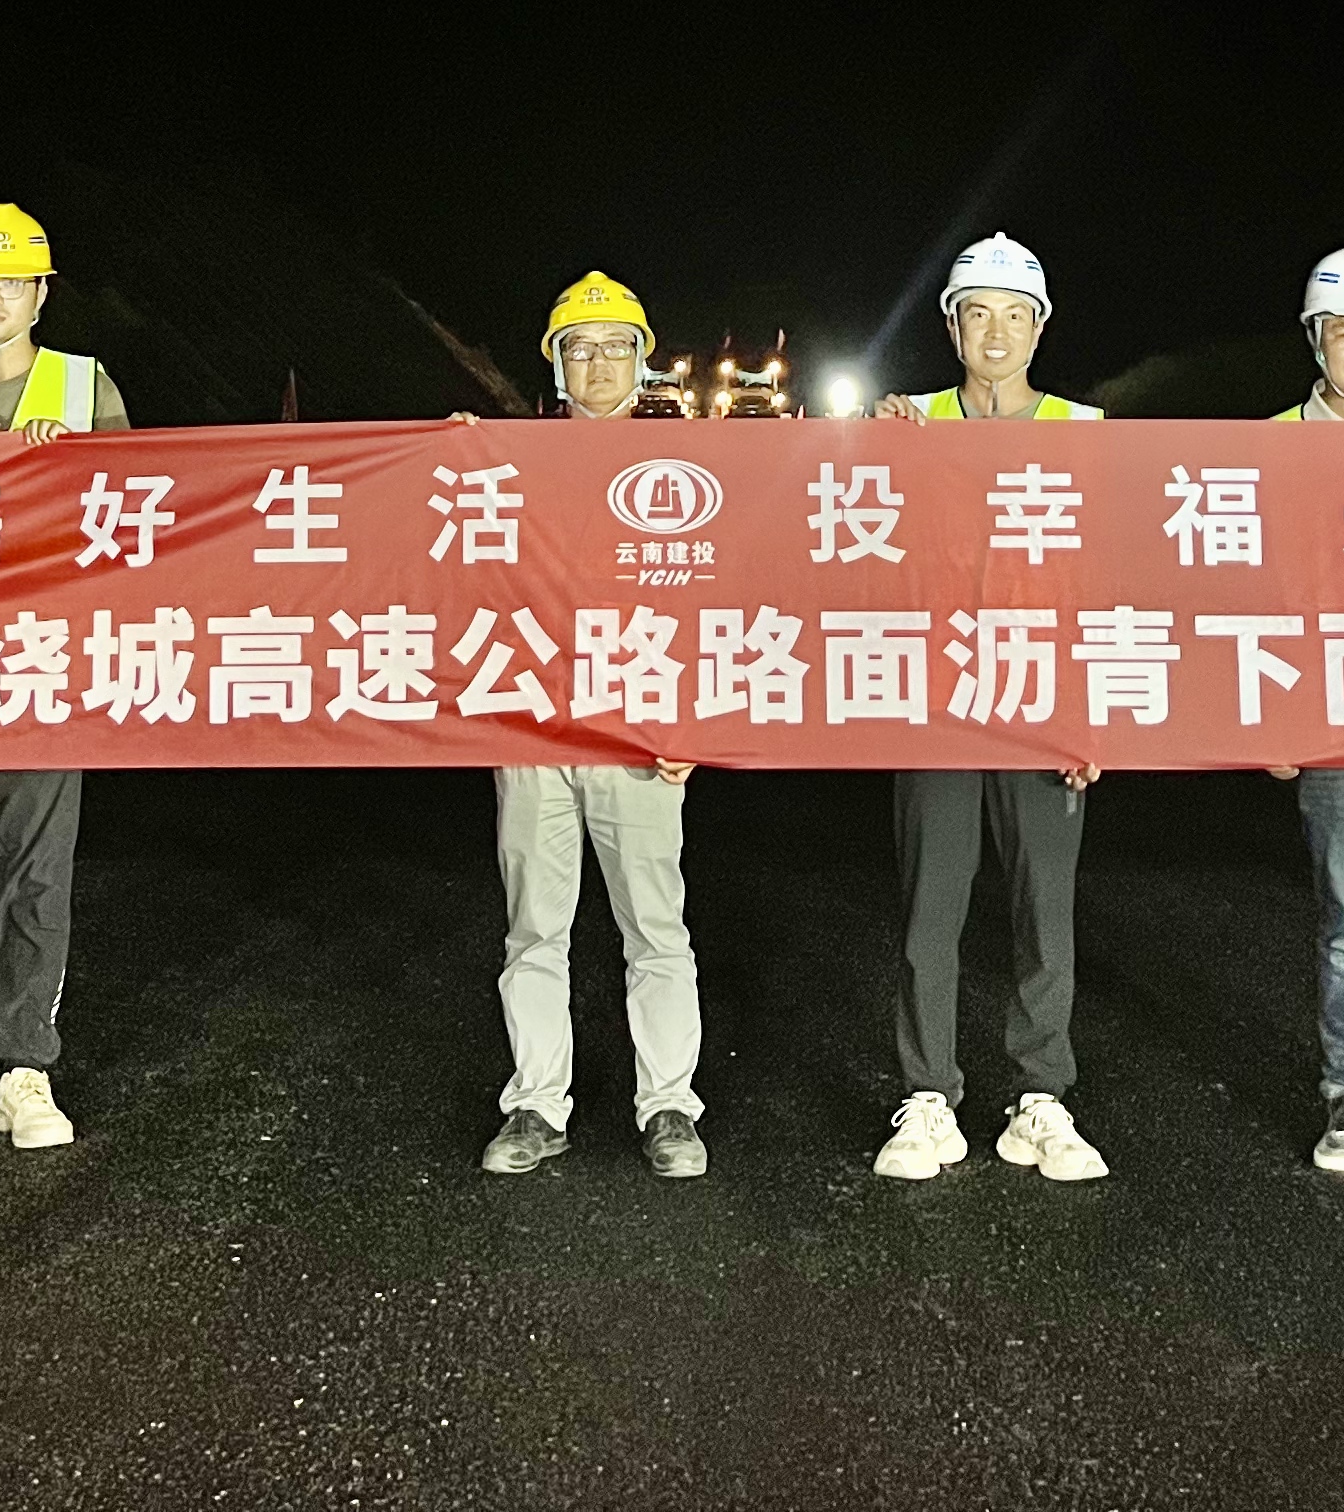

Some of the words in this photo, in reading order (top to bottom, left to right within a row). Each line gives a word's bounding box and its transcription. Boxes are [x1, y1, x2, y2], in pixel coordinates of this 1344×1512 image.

[615, 541, 716, 565] 云南建投
[637, 569, 693, 586] YCIH
